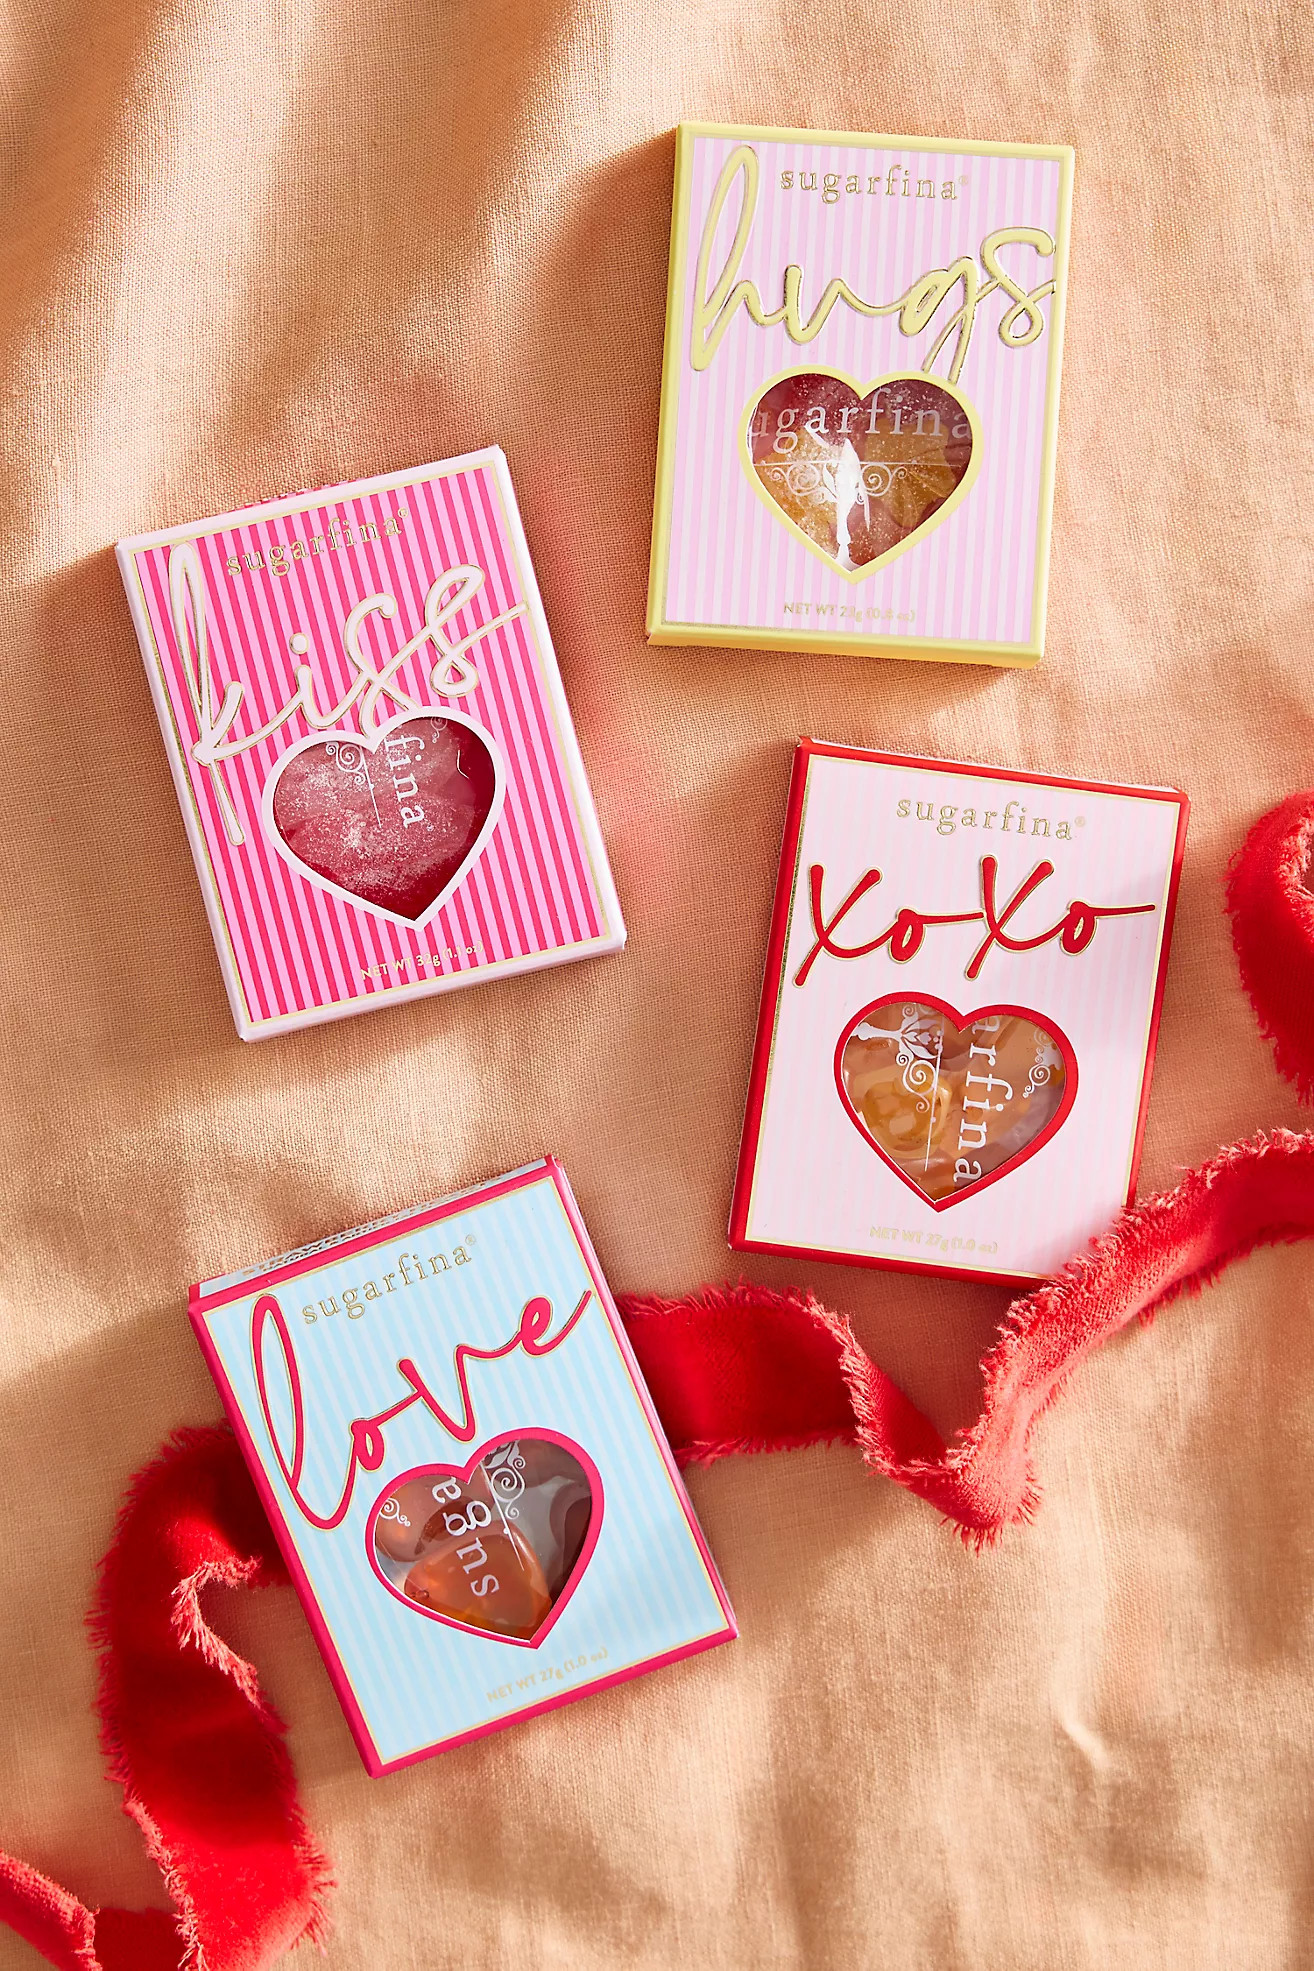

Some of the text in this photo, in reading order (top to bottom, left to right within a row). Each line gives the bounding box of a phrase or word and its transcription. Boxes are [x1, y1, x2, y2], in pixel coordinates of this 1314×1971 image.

[690, 144, 1057, 384] hugs
[783, 602, 812, 615] NET
[815, 603, 837, 616] WT
[167, 541, 531, 846] kiss
[360, 963, 388, 980] NET
[391, 957, 412, 972] WT
[415, 952, 441, 967] 32g
[466, 940, 484, 955] oz)
[869, 1225, 899, 1240] NET
[901, 1229, 923, 1244] WT
[249, 1289, 593, 1532] love
[486, 1683, 513, 1703] NET
[516, 1673, 537, 1690] WT
